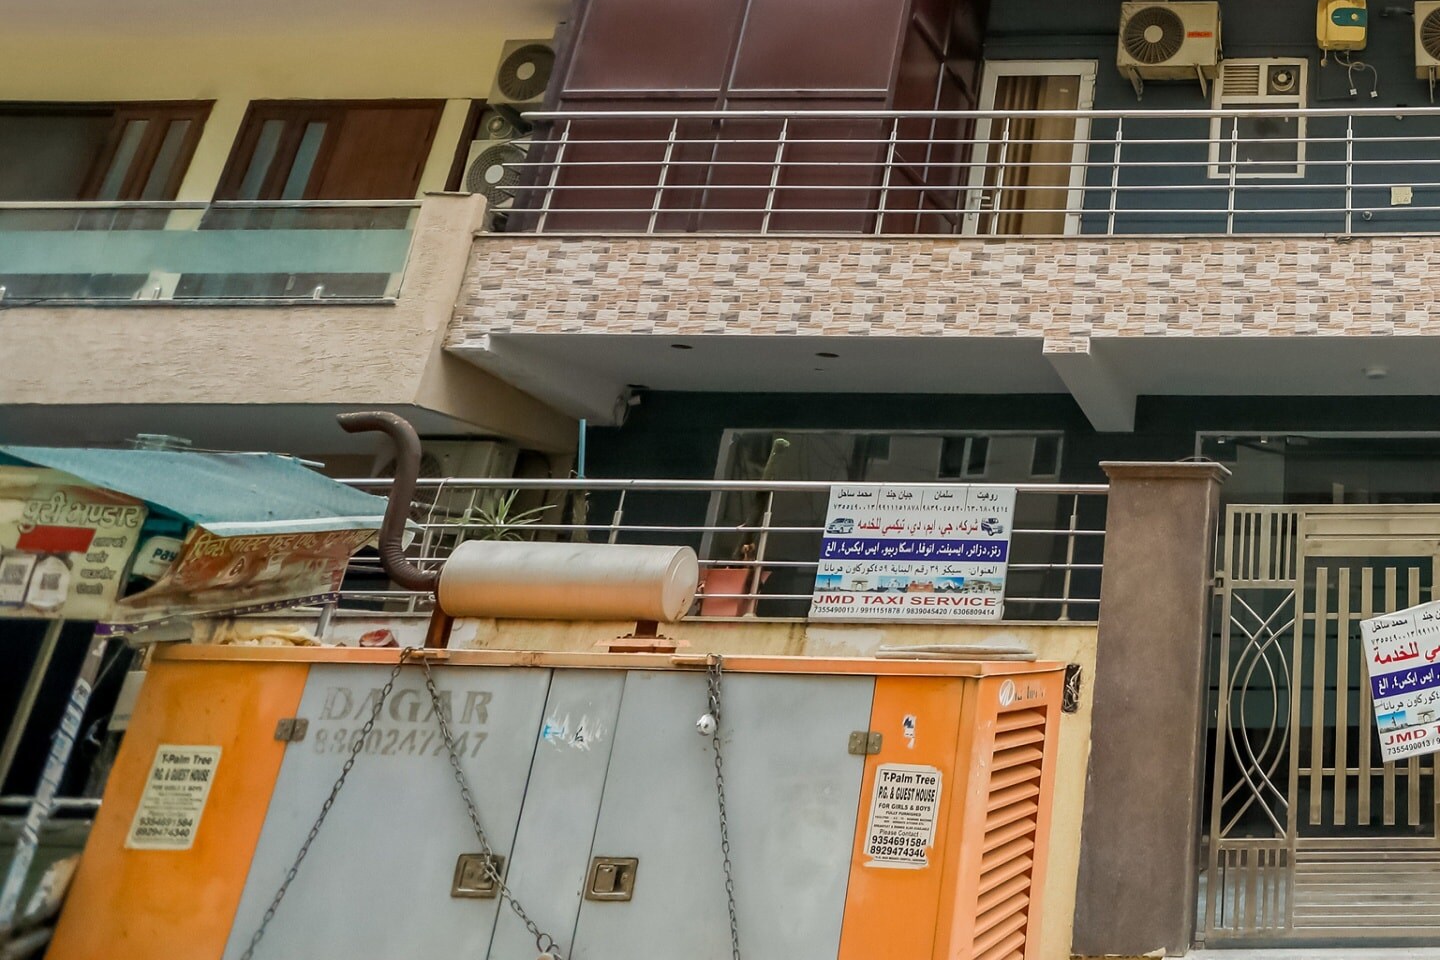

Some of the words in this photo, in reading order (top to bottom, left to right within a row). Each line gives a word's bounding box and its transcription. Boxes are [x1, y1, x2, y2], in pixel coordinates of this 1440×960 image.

[814, 595, 854, 604] JMD
[862, 596, 903, 605] TAXI
[911, 597, 996, 606] SERVICE
[907, 607, 947, 615] 9839045420
[953, 608, 995, 616] 6306809414
[1392, 619, 1408, 627] محمد
[1373, 641, 1419, 664] للخدمة
[318, 687, 492, 724] DAGAR
[1384, 729, 1428, 745] JMD
[1387, 739, 1431, 755] 7355490013
[194, 754, 212, 765] Tree
[916, 774, 936, 785] Tree
[890, 786, 895, 799] &
[896, 787, 915, 800] GUEST
[915, 788, 935, 802] HOUSE
[872, 835, 927, 847] 9354691584
[870, 845, 925, 857] 8929474340
